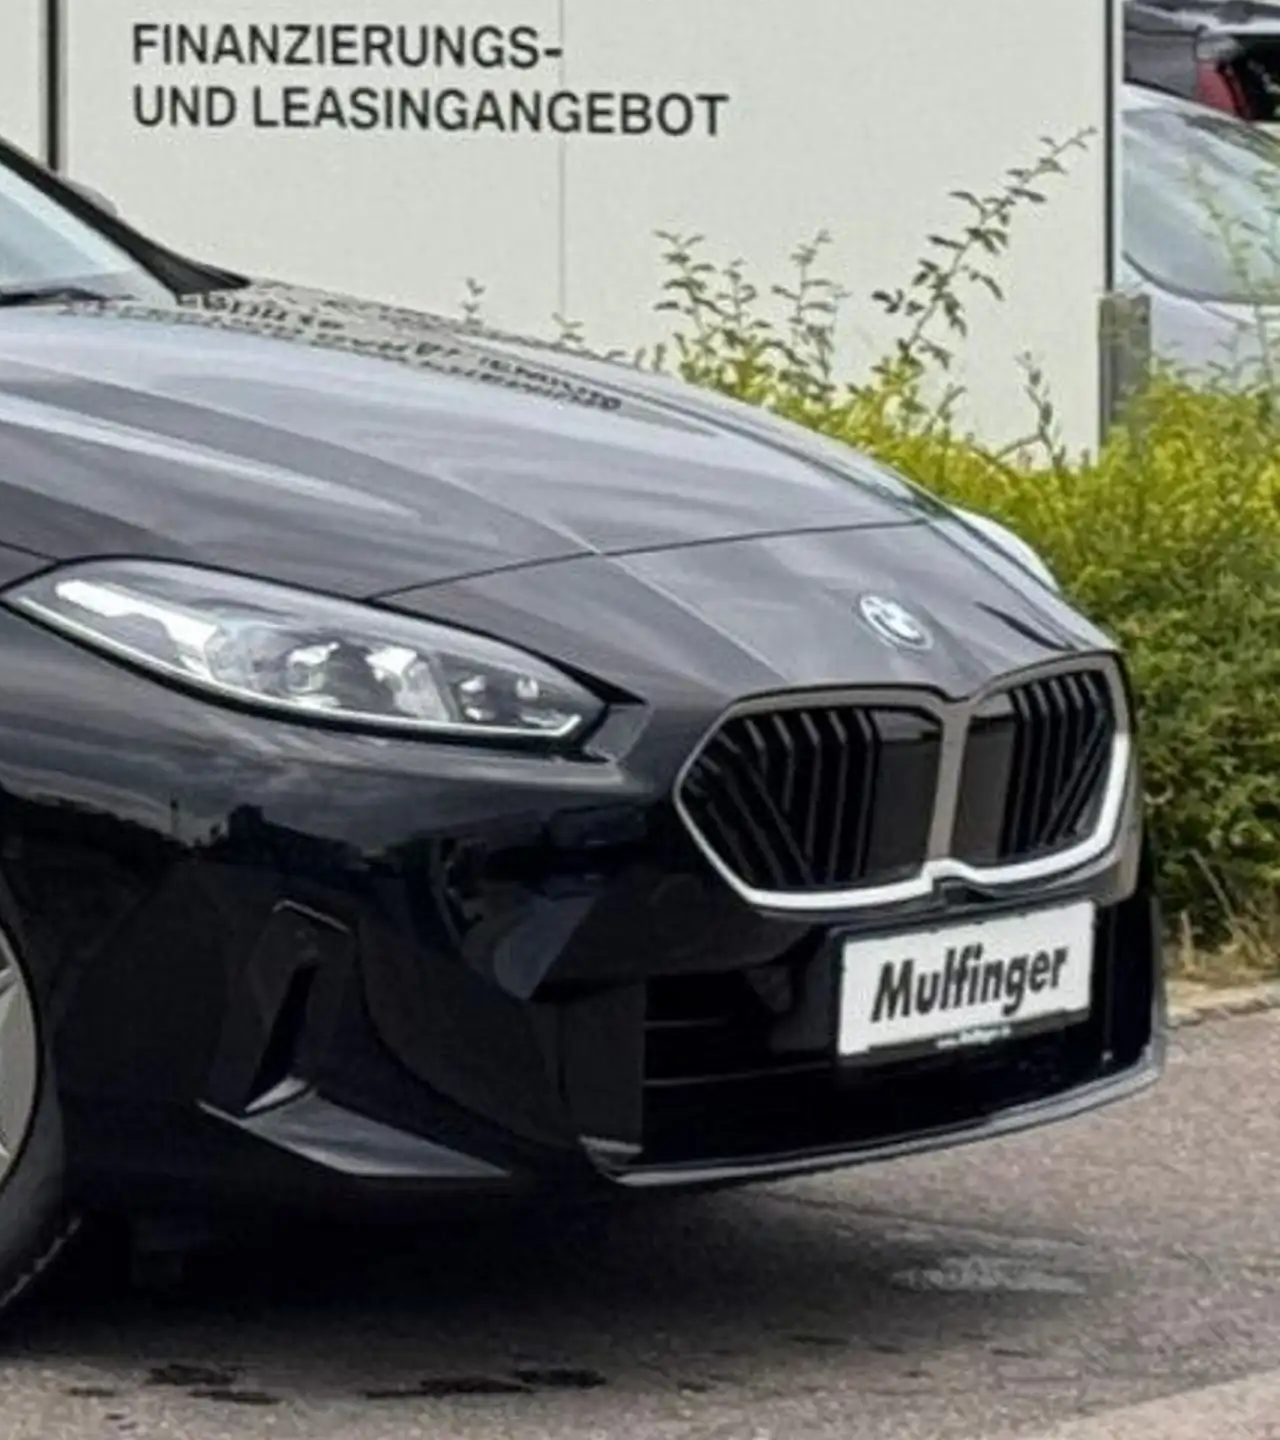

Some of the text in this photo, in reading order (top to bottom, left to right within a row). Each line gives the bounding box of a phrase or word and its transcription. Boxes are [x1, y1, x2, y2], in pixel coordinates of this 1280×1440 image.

[134, 24, 562, 69] FINANZIERUNGS-
[135, 86, 728, 136] UND LEASINGANGEBOT
[871, 944, 1068, 1021] Mulfinger
